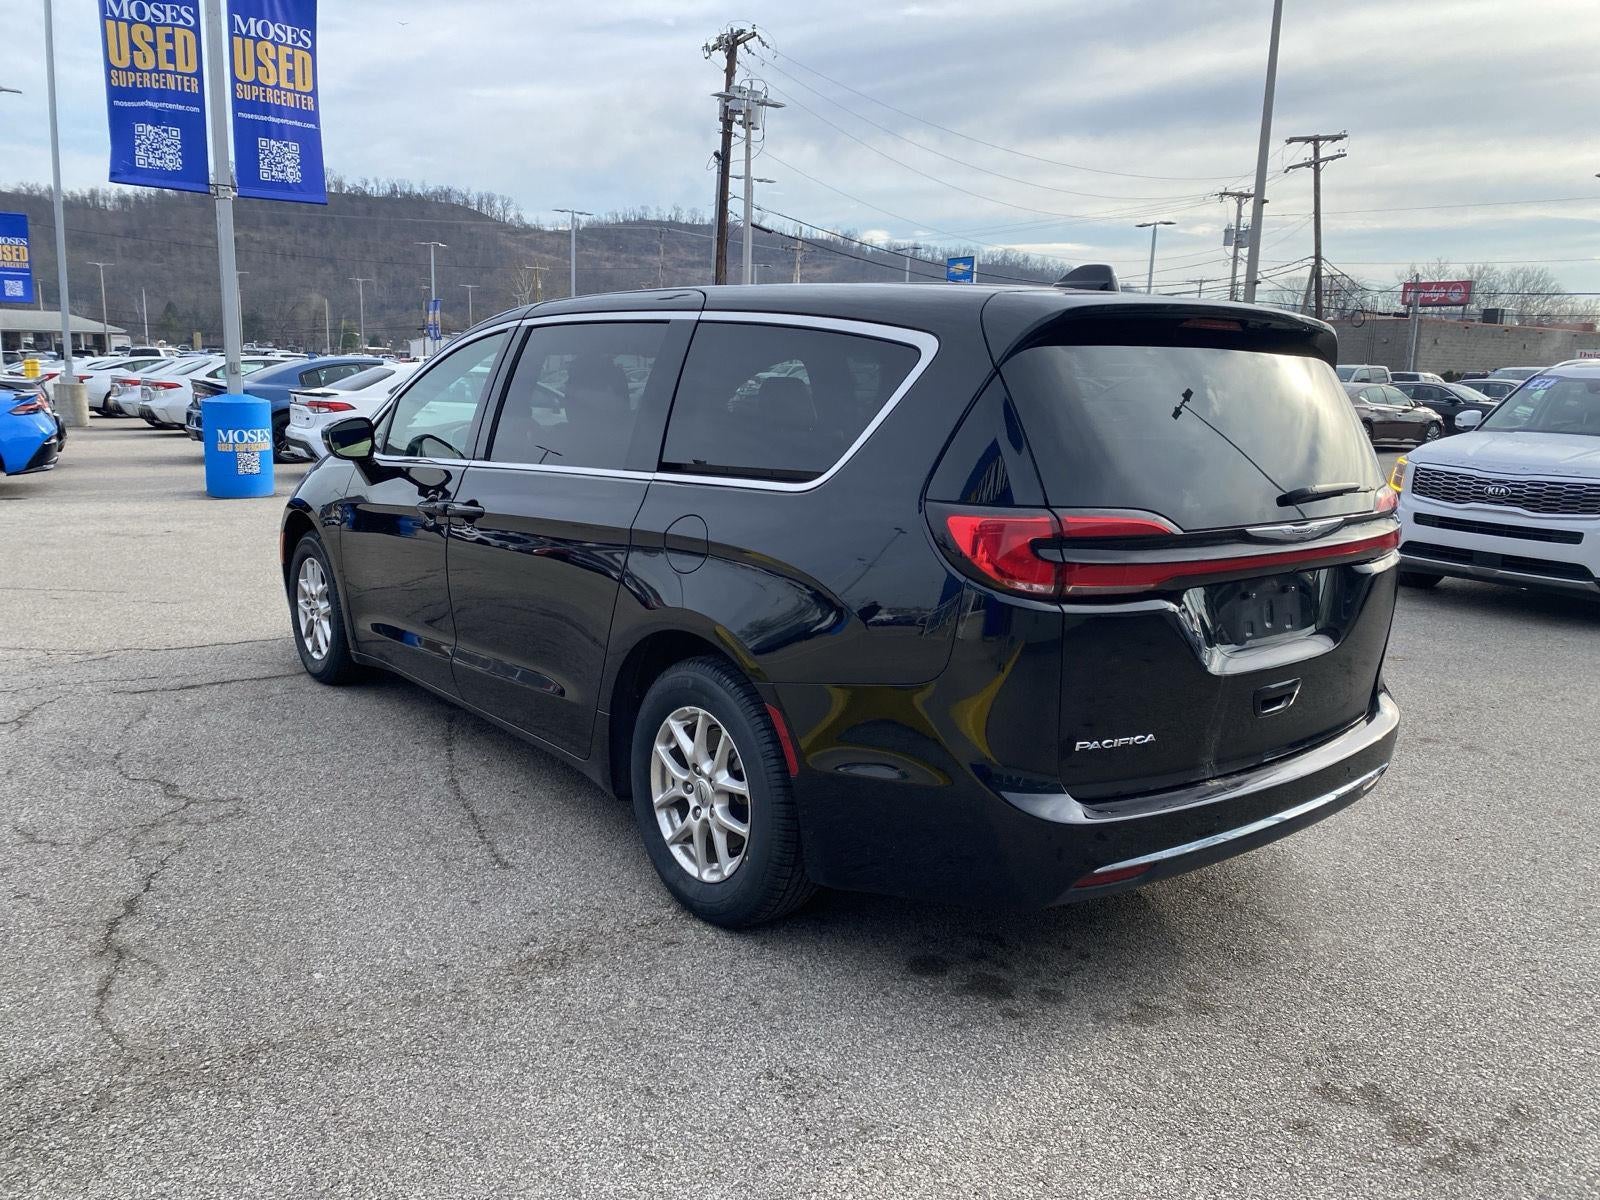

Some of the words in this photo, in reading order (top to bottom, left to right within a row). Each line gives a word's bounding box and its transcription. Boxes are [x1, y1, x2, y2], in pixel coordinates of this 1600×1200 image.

[104, 0, 195, 27] MOSES
[232, 13, 312, 49] MOSES
[105, 19, 198, 74] USED
[233, 36, 314, 93] USED
[110, 69, 199, 94] SUPERCENTER
[113, 99, 200, 114] mosesusedsupercenter.com
[236, 83, 315, 112] SUPERCENTER
[237, 112, 317, 129] mosesusedsupercenter.com
[0, 236, 28, 246] OSES
[216, 428, 271, 444] MOSES
[1487, 486, 1507, 496] KIA
[1074, 733, 1157, 752] PACIFICA
